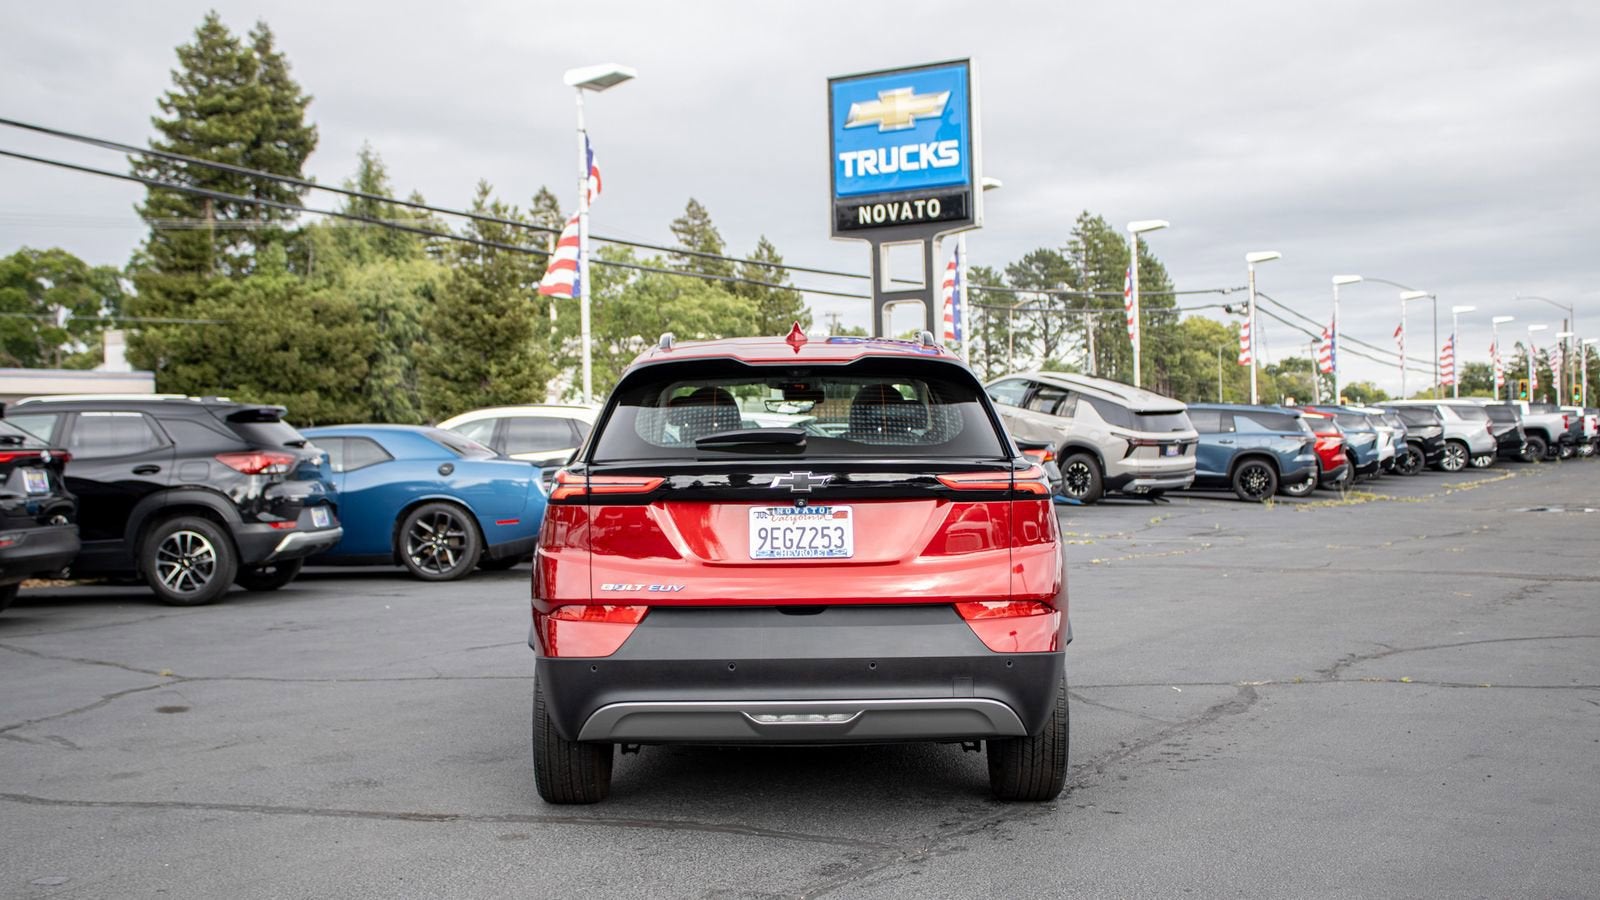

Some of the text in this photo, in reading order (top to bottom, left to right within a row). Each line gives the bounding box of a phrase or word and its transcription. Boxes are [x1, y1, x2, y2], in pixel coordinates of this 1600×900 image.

[839, 139, 960, 178] TRUCKS
[858, 198, 941, 225] NOVATO
[758, 526, 845, 550] 9EGZ253
[600, 583, 686, 592] BOLT EUV
